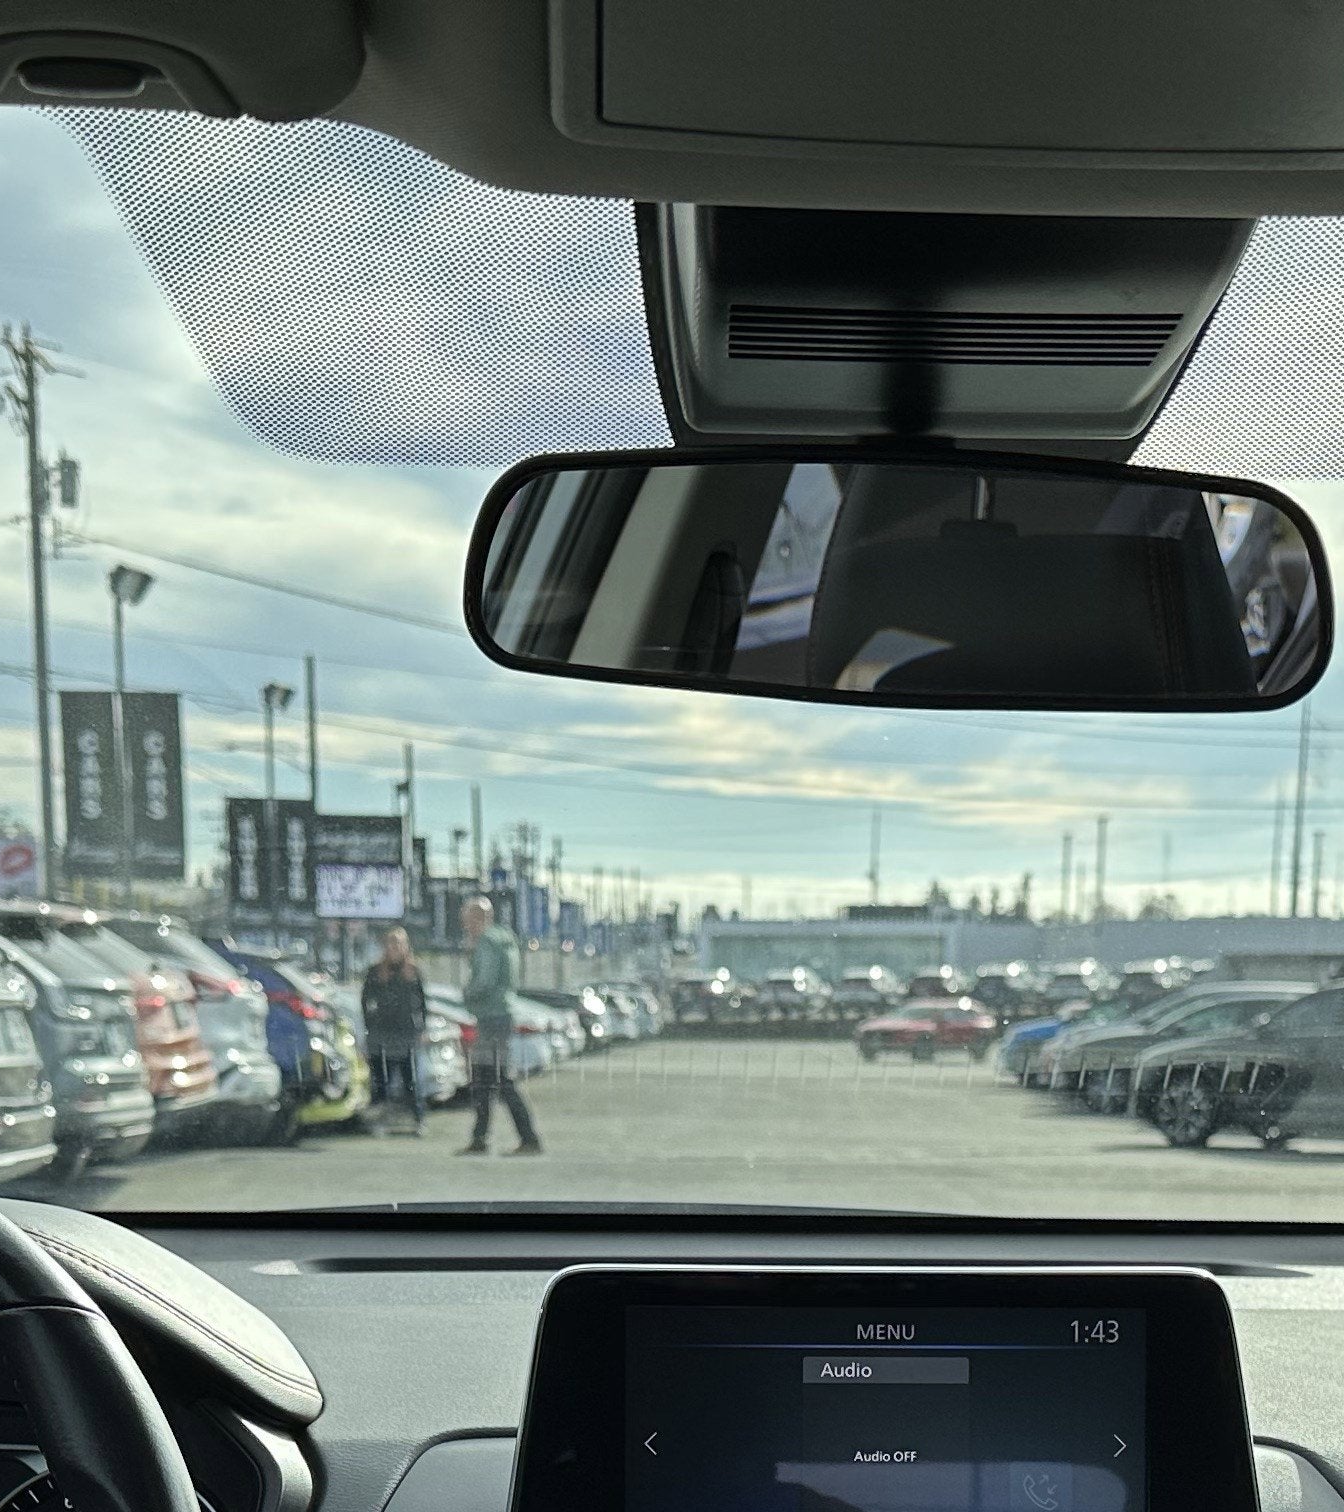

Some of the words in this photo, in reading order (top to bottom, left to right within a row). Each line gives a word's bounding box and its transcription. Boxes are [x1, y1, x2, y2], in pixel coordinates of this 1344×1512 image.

[855, 1323, 916, 1341] MENU
[1069, 1319, 1120, 1344] 1:43
[820, 1361, 873, 1379] Audio
[853, 1450, 891, 1463] Audio
[893, 1450, 918, 1463] OFF
